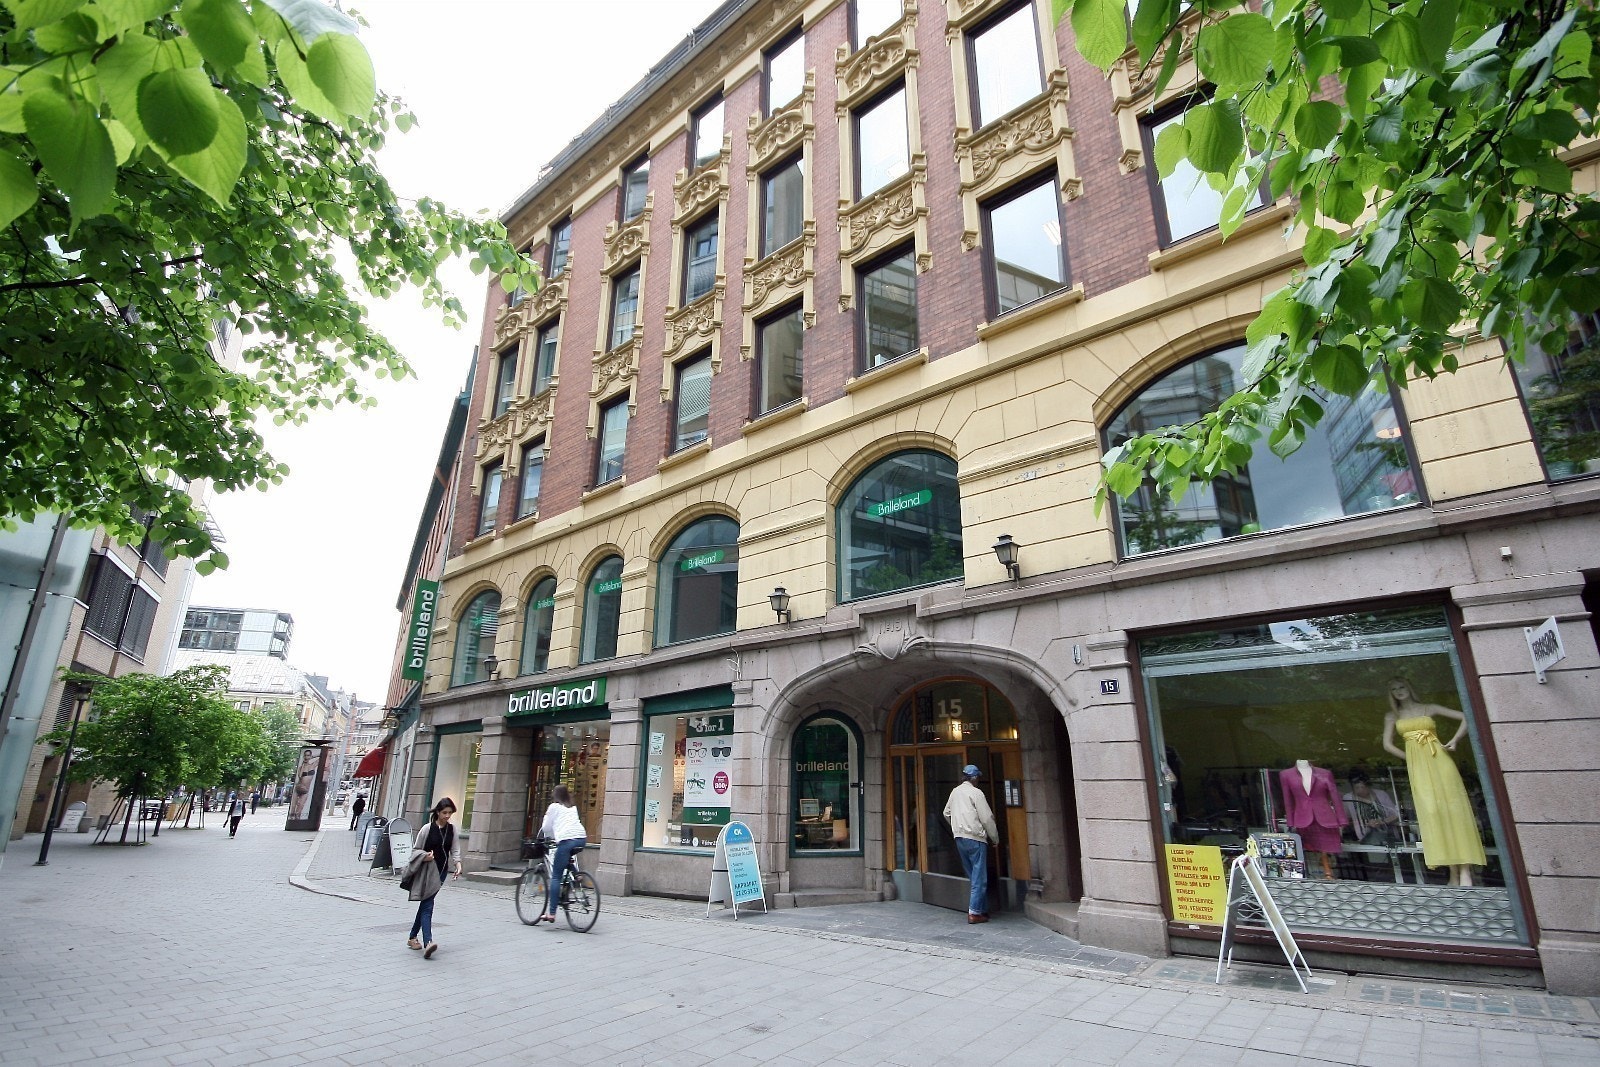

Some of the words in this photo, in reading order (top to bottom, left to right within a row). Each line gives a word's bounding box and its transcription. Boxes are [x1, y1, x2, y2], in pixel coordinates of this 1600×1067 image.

[878, 493, 920, 516] Brilleland
[688, 552, 717, 569] Brilleland
[409, 589, 434, 669] brilleland
[508, 680, 596, 713] brilleland
[1104, 681, 1114, 692] 15
[938, 698, 963, 718] 15
[718, 719, 725, 731] 1
